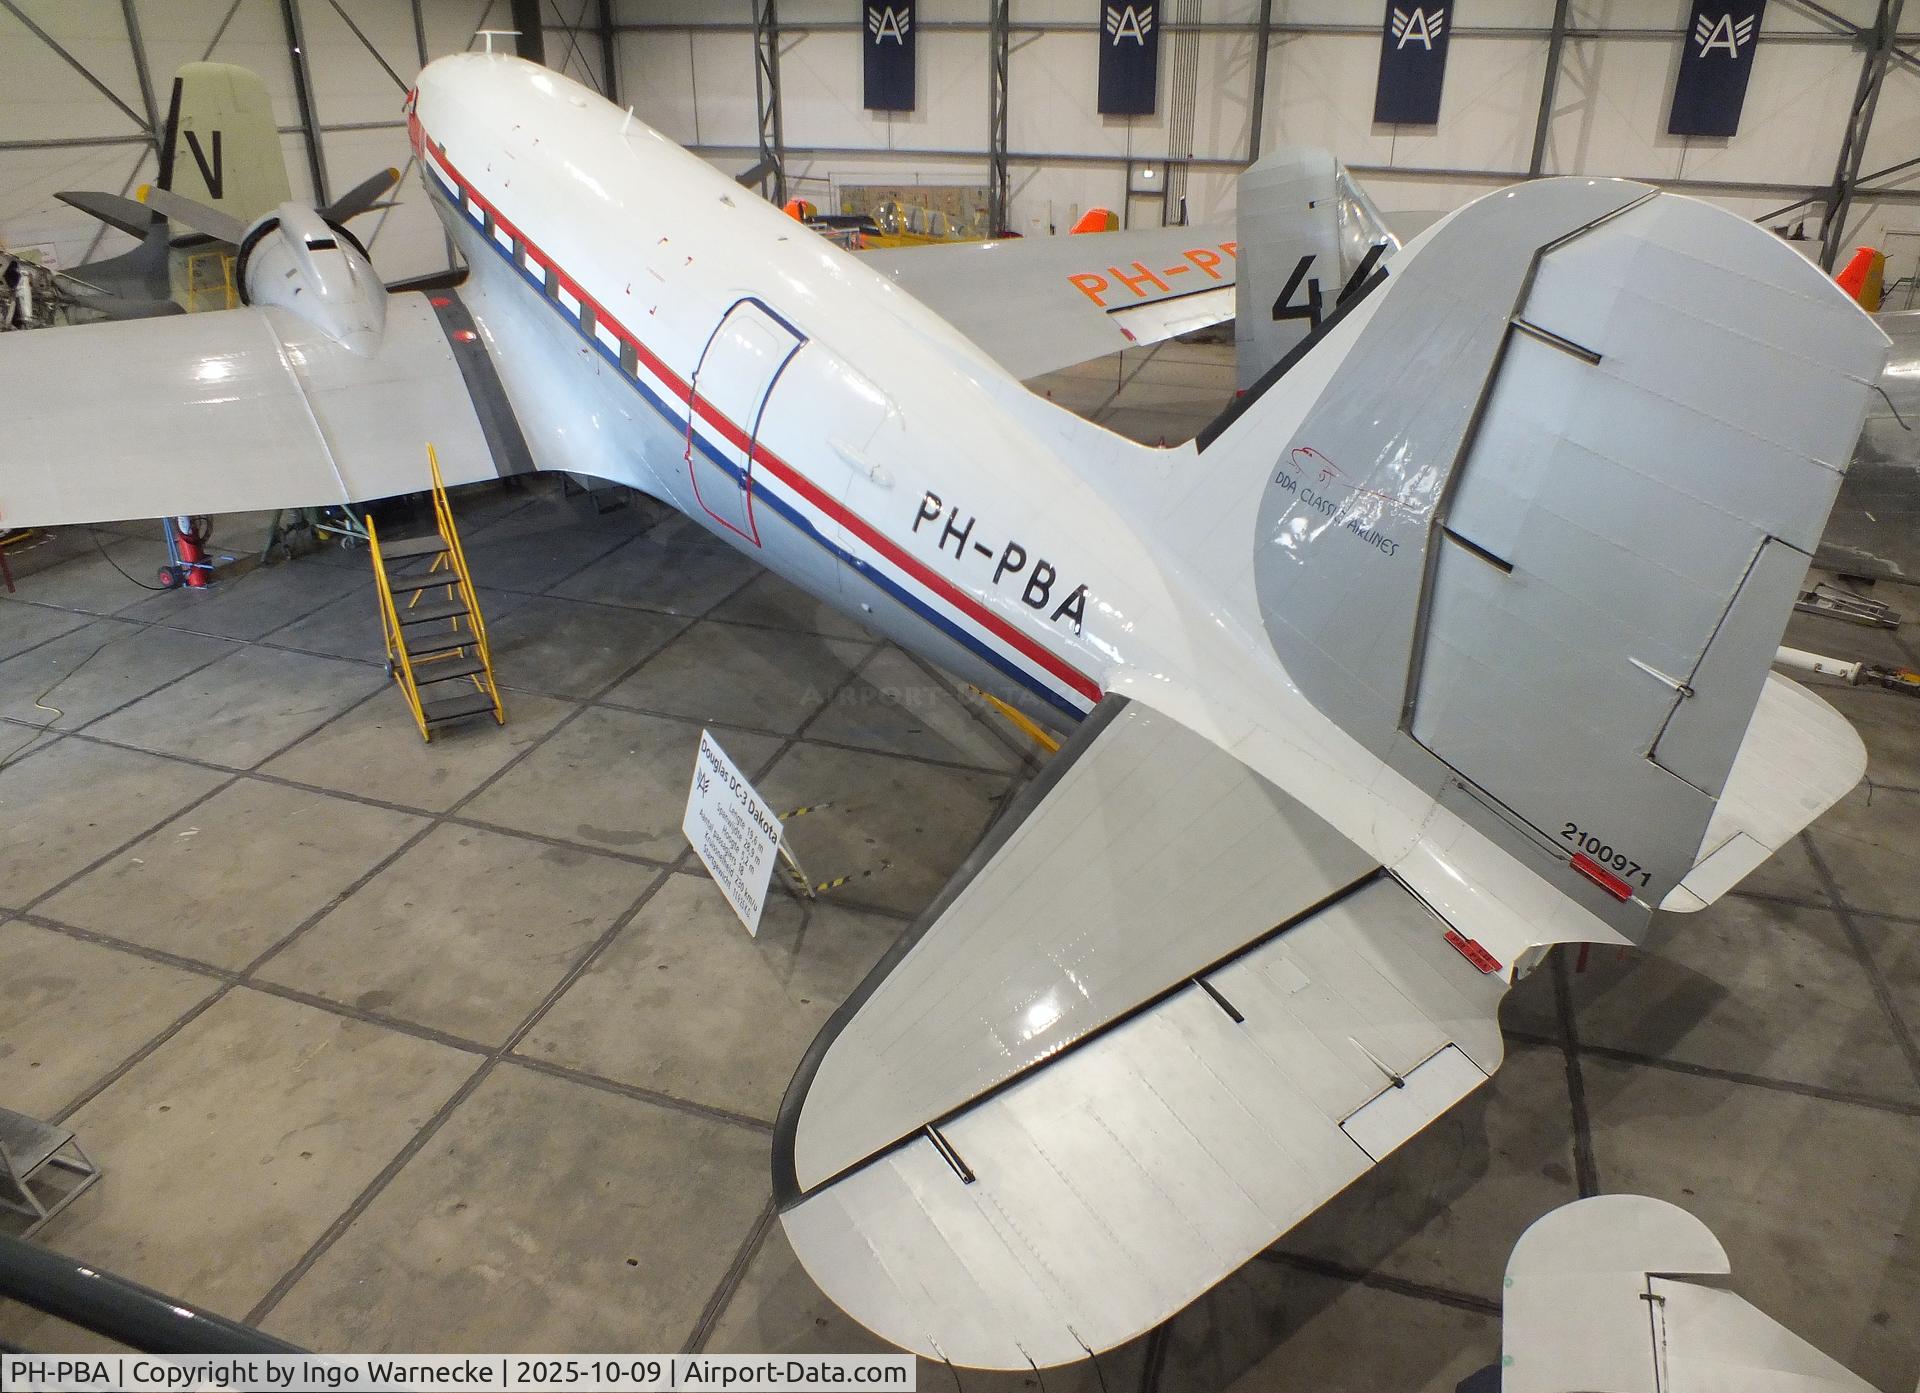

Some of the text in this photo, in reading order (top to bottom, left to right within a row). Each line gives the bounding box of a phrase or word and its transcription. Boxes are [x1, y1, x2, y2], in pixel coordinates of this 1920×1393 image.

[1066, 241, 1237, 308] PH-P
[1274, 471, 1298, 494] DDA
[911, 489, 1089, 638] PH-PBA
[701, 738, 778, 846] Douglas DC-3 Dakota
[1559, 822, 1653, 888] 2100971
